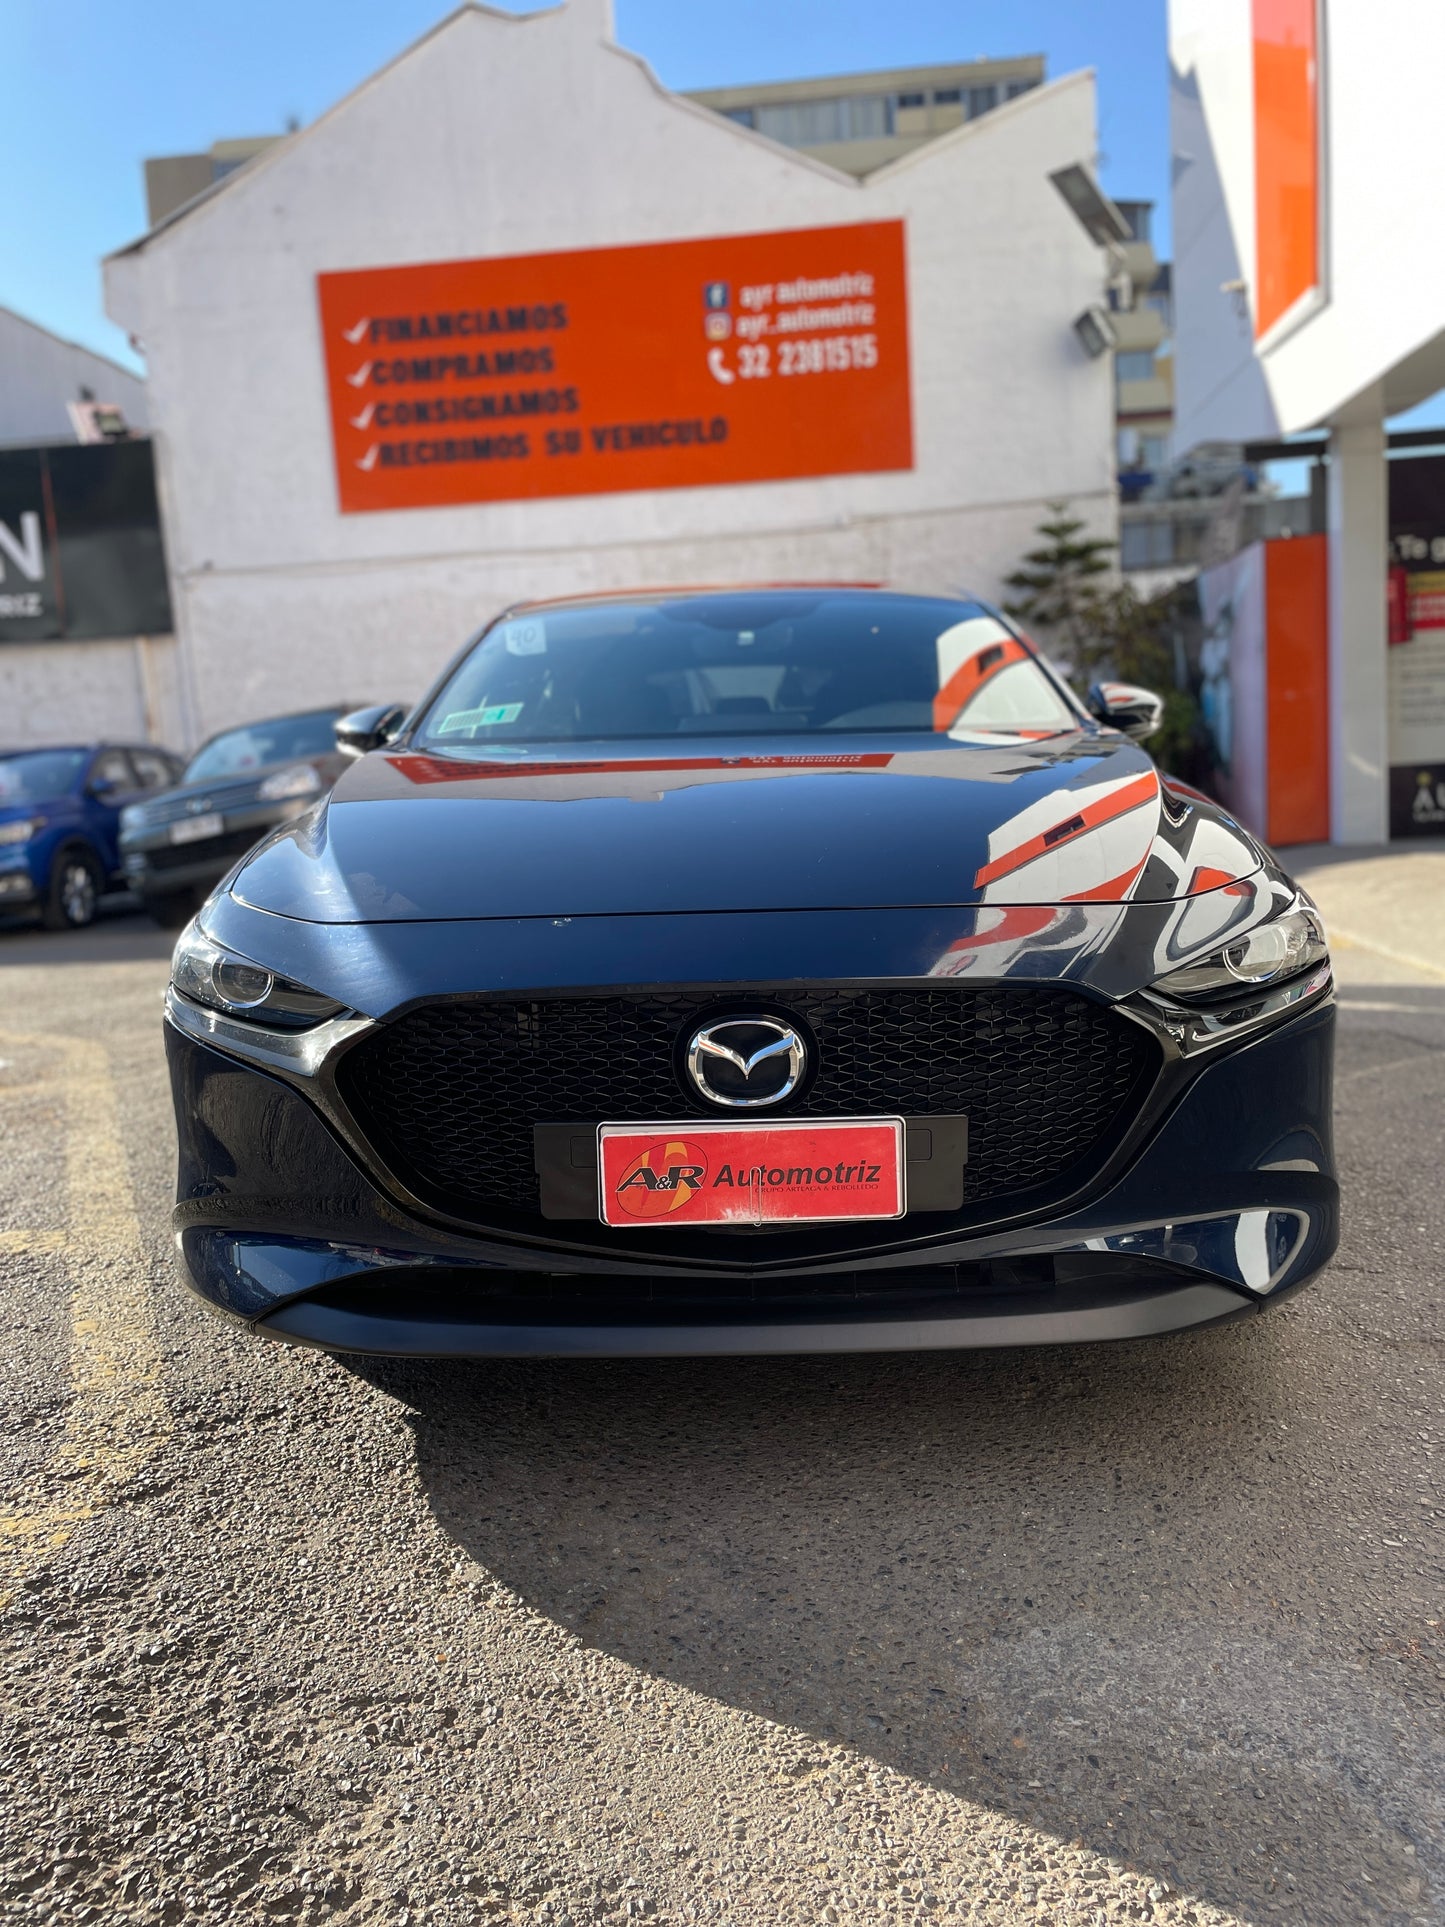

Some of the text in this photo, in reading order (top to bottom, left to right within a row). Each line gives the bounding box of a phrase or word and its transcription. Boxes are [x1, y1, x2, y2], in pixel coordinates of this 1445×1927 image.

[776, 271, 875, 305] automotriz
[369, 303, 568, 344] FINANCIAMOS
[372, 346, 554, 385] COMPRAMOS
[737, 344, 771, 379] 32
[374, 387, 579, 427] CONSIGNAMOS
[379, 416, 728, 468] RECIBIMOS SU VEHICULO
[615, 1160, 881, 1193] A&R Automotriz
